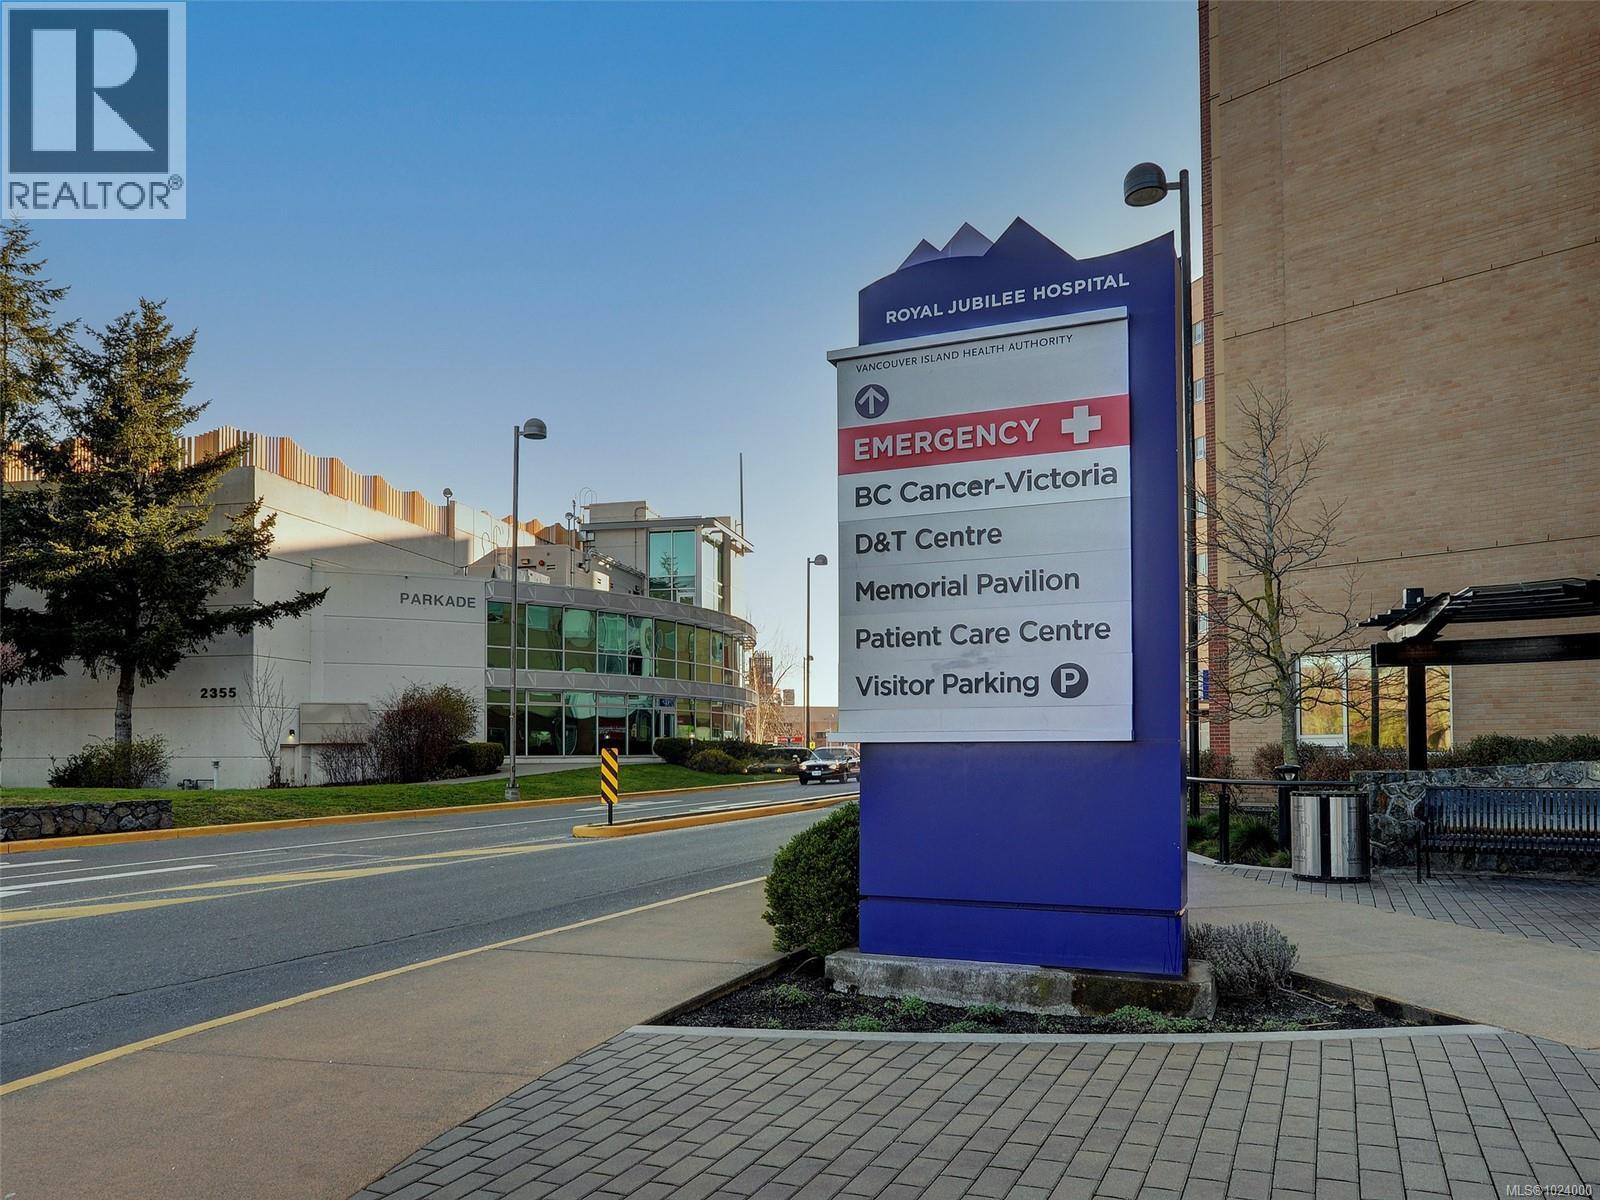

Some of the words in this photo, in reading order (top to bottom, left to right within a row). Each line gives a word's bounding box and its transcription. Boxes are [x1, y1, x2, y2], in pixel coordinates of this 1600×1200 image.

[886, 304, 943, 324] ROYAL
[948, 289, 1026, 314] JUBILEE
[1033, 272, 1130, 300] HOSPITAL
[855, 356, 918, 373] VANCOUVER
[920, 351, 960, 364] ISLAND
[963, 344, 1005, 358] HEALTH
[1008, 334, 1073, 351] AUTHORITY
[854, 418, 1040, 461] EMERGENCY
[855, 484, 892, 508] BC
[900, 463, 1118, 503] Cancer-Victoria
[855, 530, 906, 554] D&T
[915, 525, 1003, 550] Centre
[400, 592, 477, 609] PARKADE
[855, 574, 968, 602] Memorial
[976, 569, 1080, 595] Pavilion
[855, 626, 942, 649] Patient
[949, 623, 1011, 645] Care
[1018, 619, 1111, 643] Centre
[200, 687, 237, 699] 2355
[855, 674, 935, 697] Visitor
[942, 671, 1040, 698] Parking
[1060, 668, 1081, 694] P
